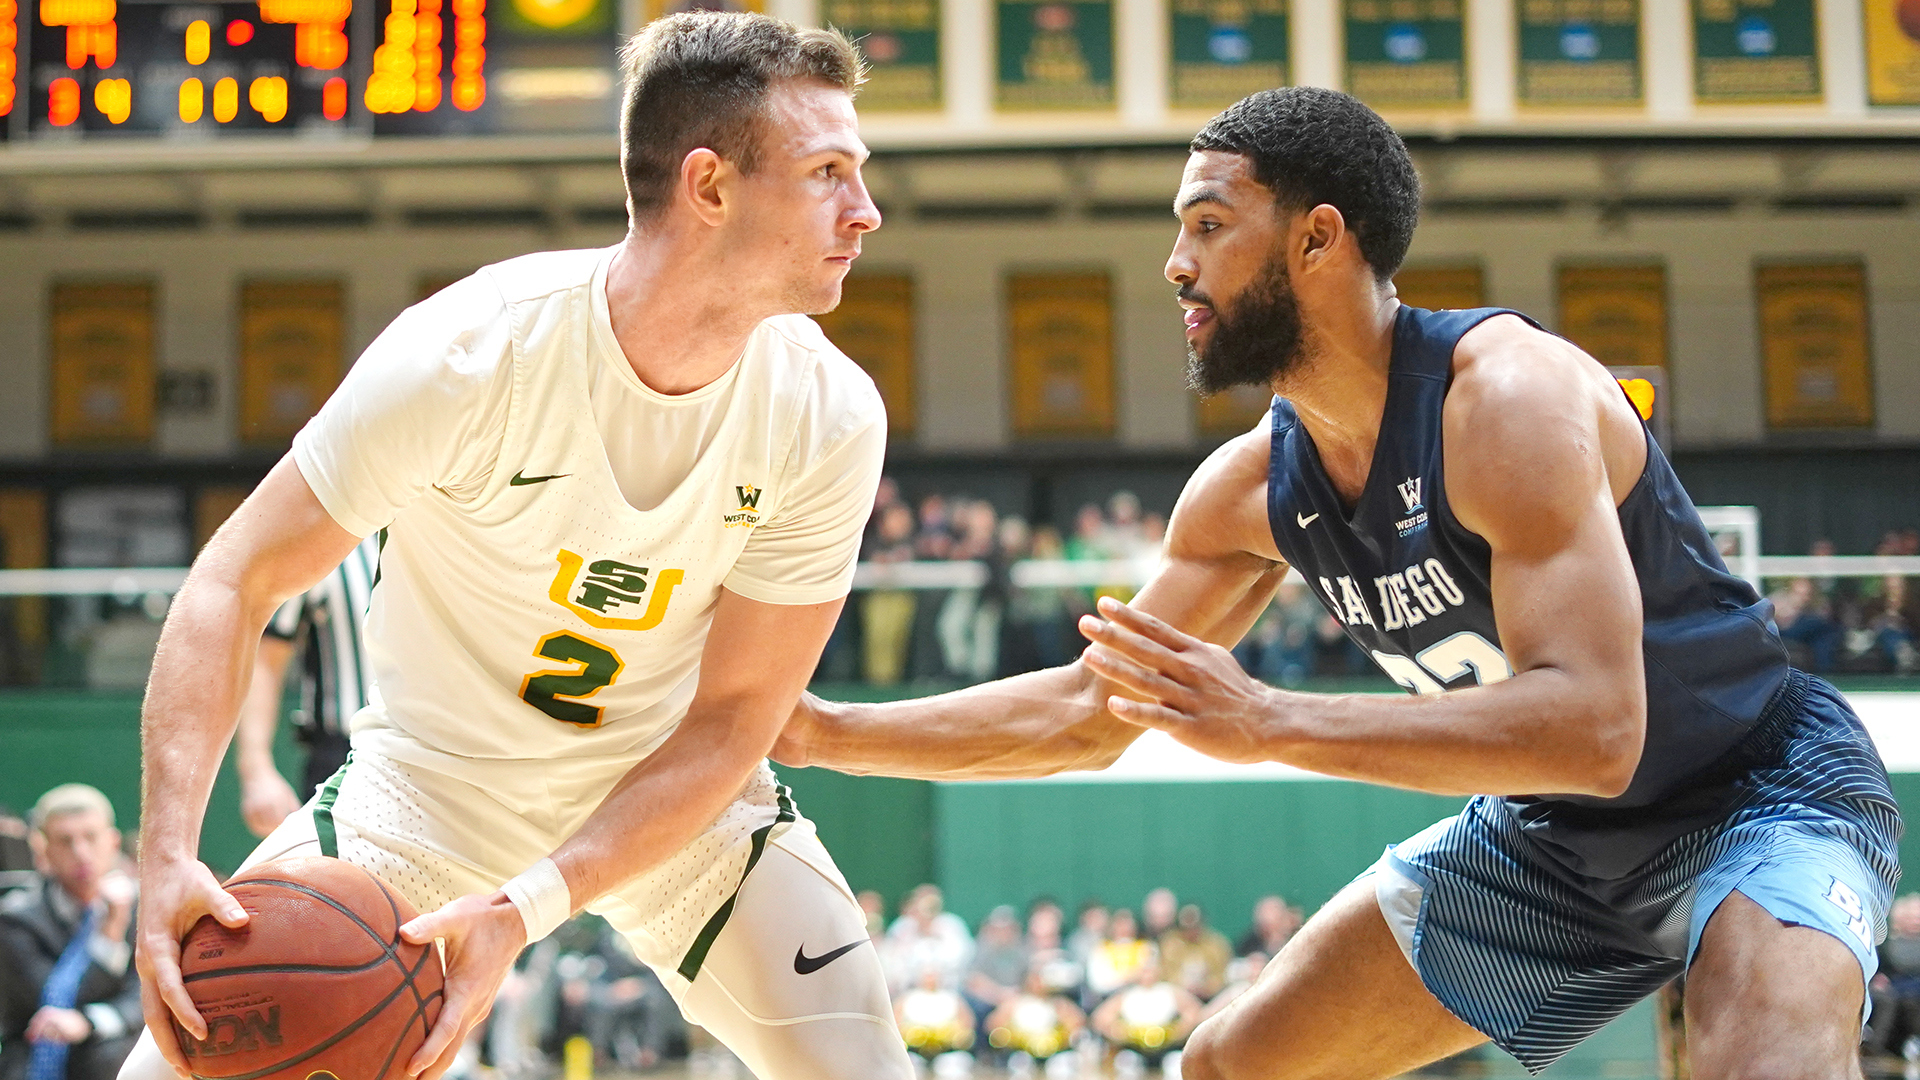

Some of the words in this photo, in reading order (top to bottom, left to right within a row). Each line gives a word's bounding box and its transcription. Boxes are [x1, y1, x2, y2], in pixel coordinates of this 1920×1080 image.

[724, 514, 746, 522] WEST
[1395, 516, 1417, 531] WEST
[518, 629, 626, 729] 2
